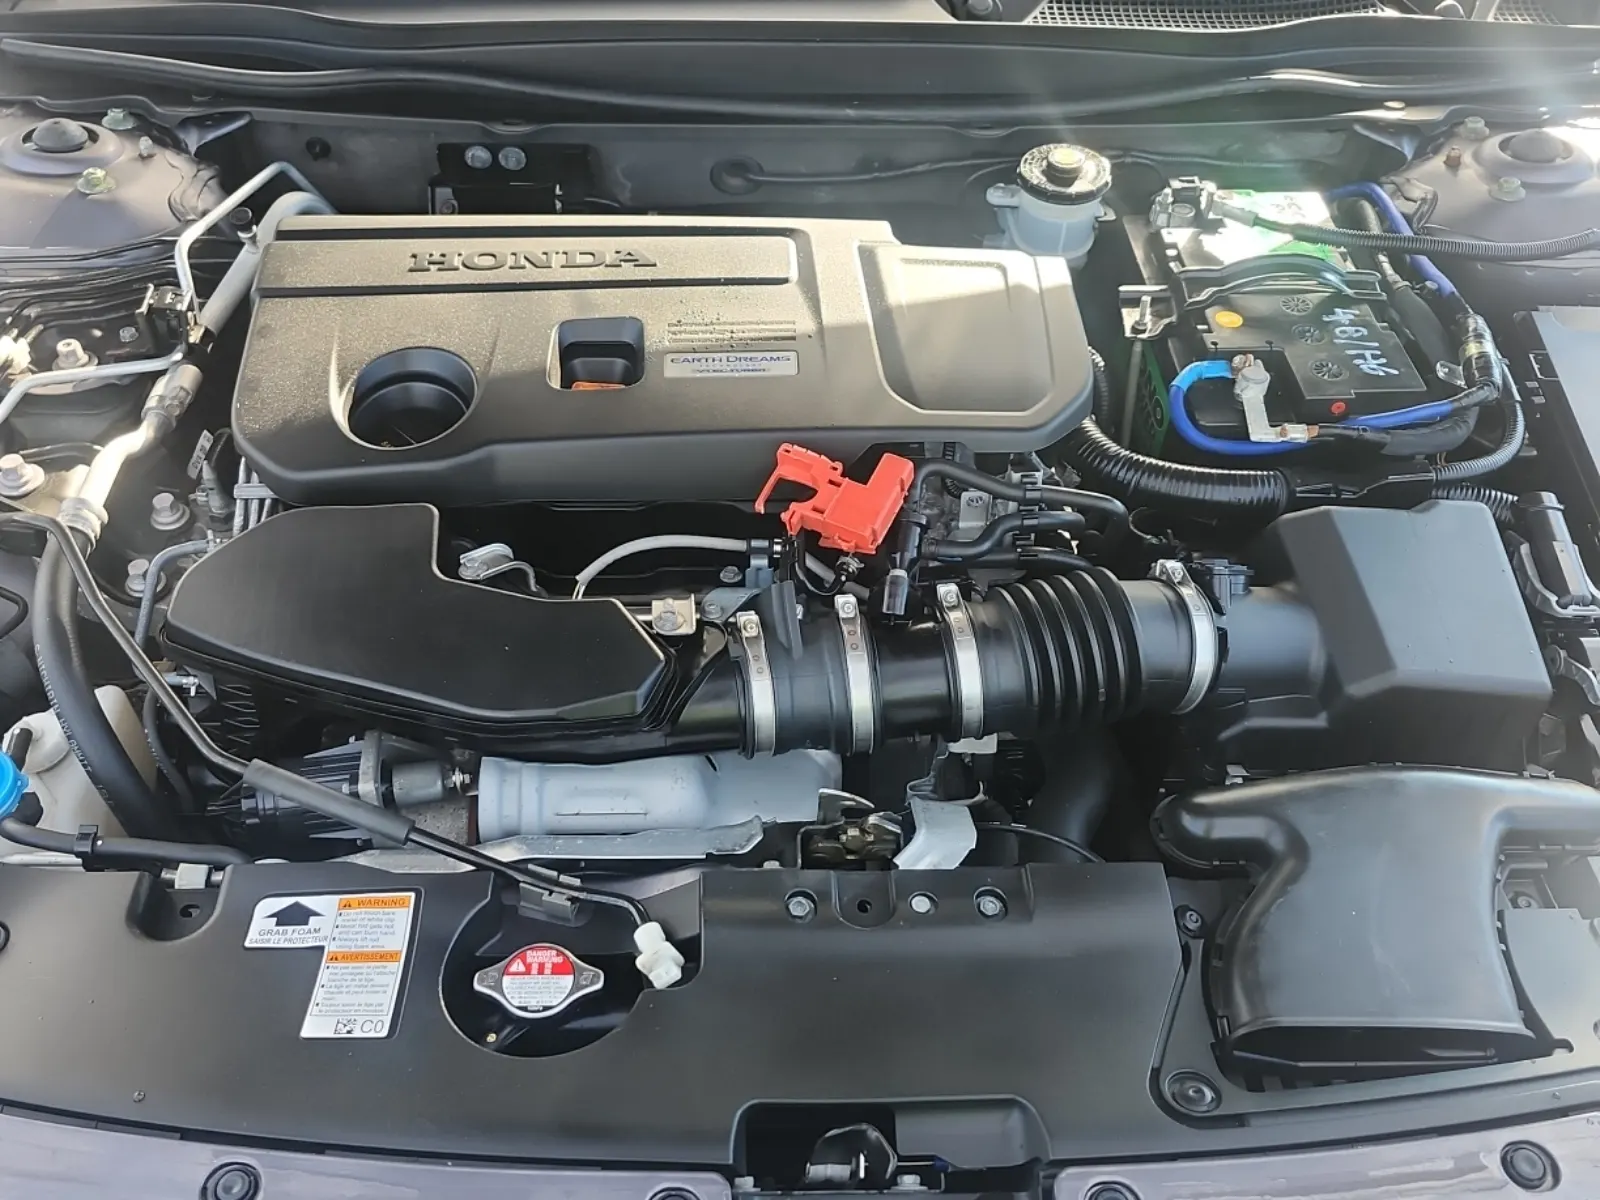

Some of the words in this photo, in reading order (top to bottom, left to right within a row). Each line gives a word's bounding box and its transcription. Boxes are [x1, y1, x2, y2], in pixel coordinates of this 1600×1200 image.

[408, 249, 657, 272] HONDA
[670, 356, 722, 364] EARTH
[726, 355, 791, 363] DREAMS
[357, 899, 406, 907] WARNING
[258, 928, 288, 937] GRAB
[290, 927, 321, 936] FOAM
[283, 935, 329, 944] PROTECTEUR
[341, 952, 399, 960] AVERTISSEMENT
